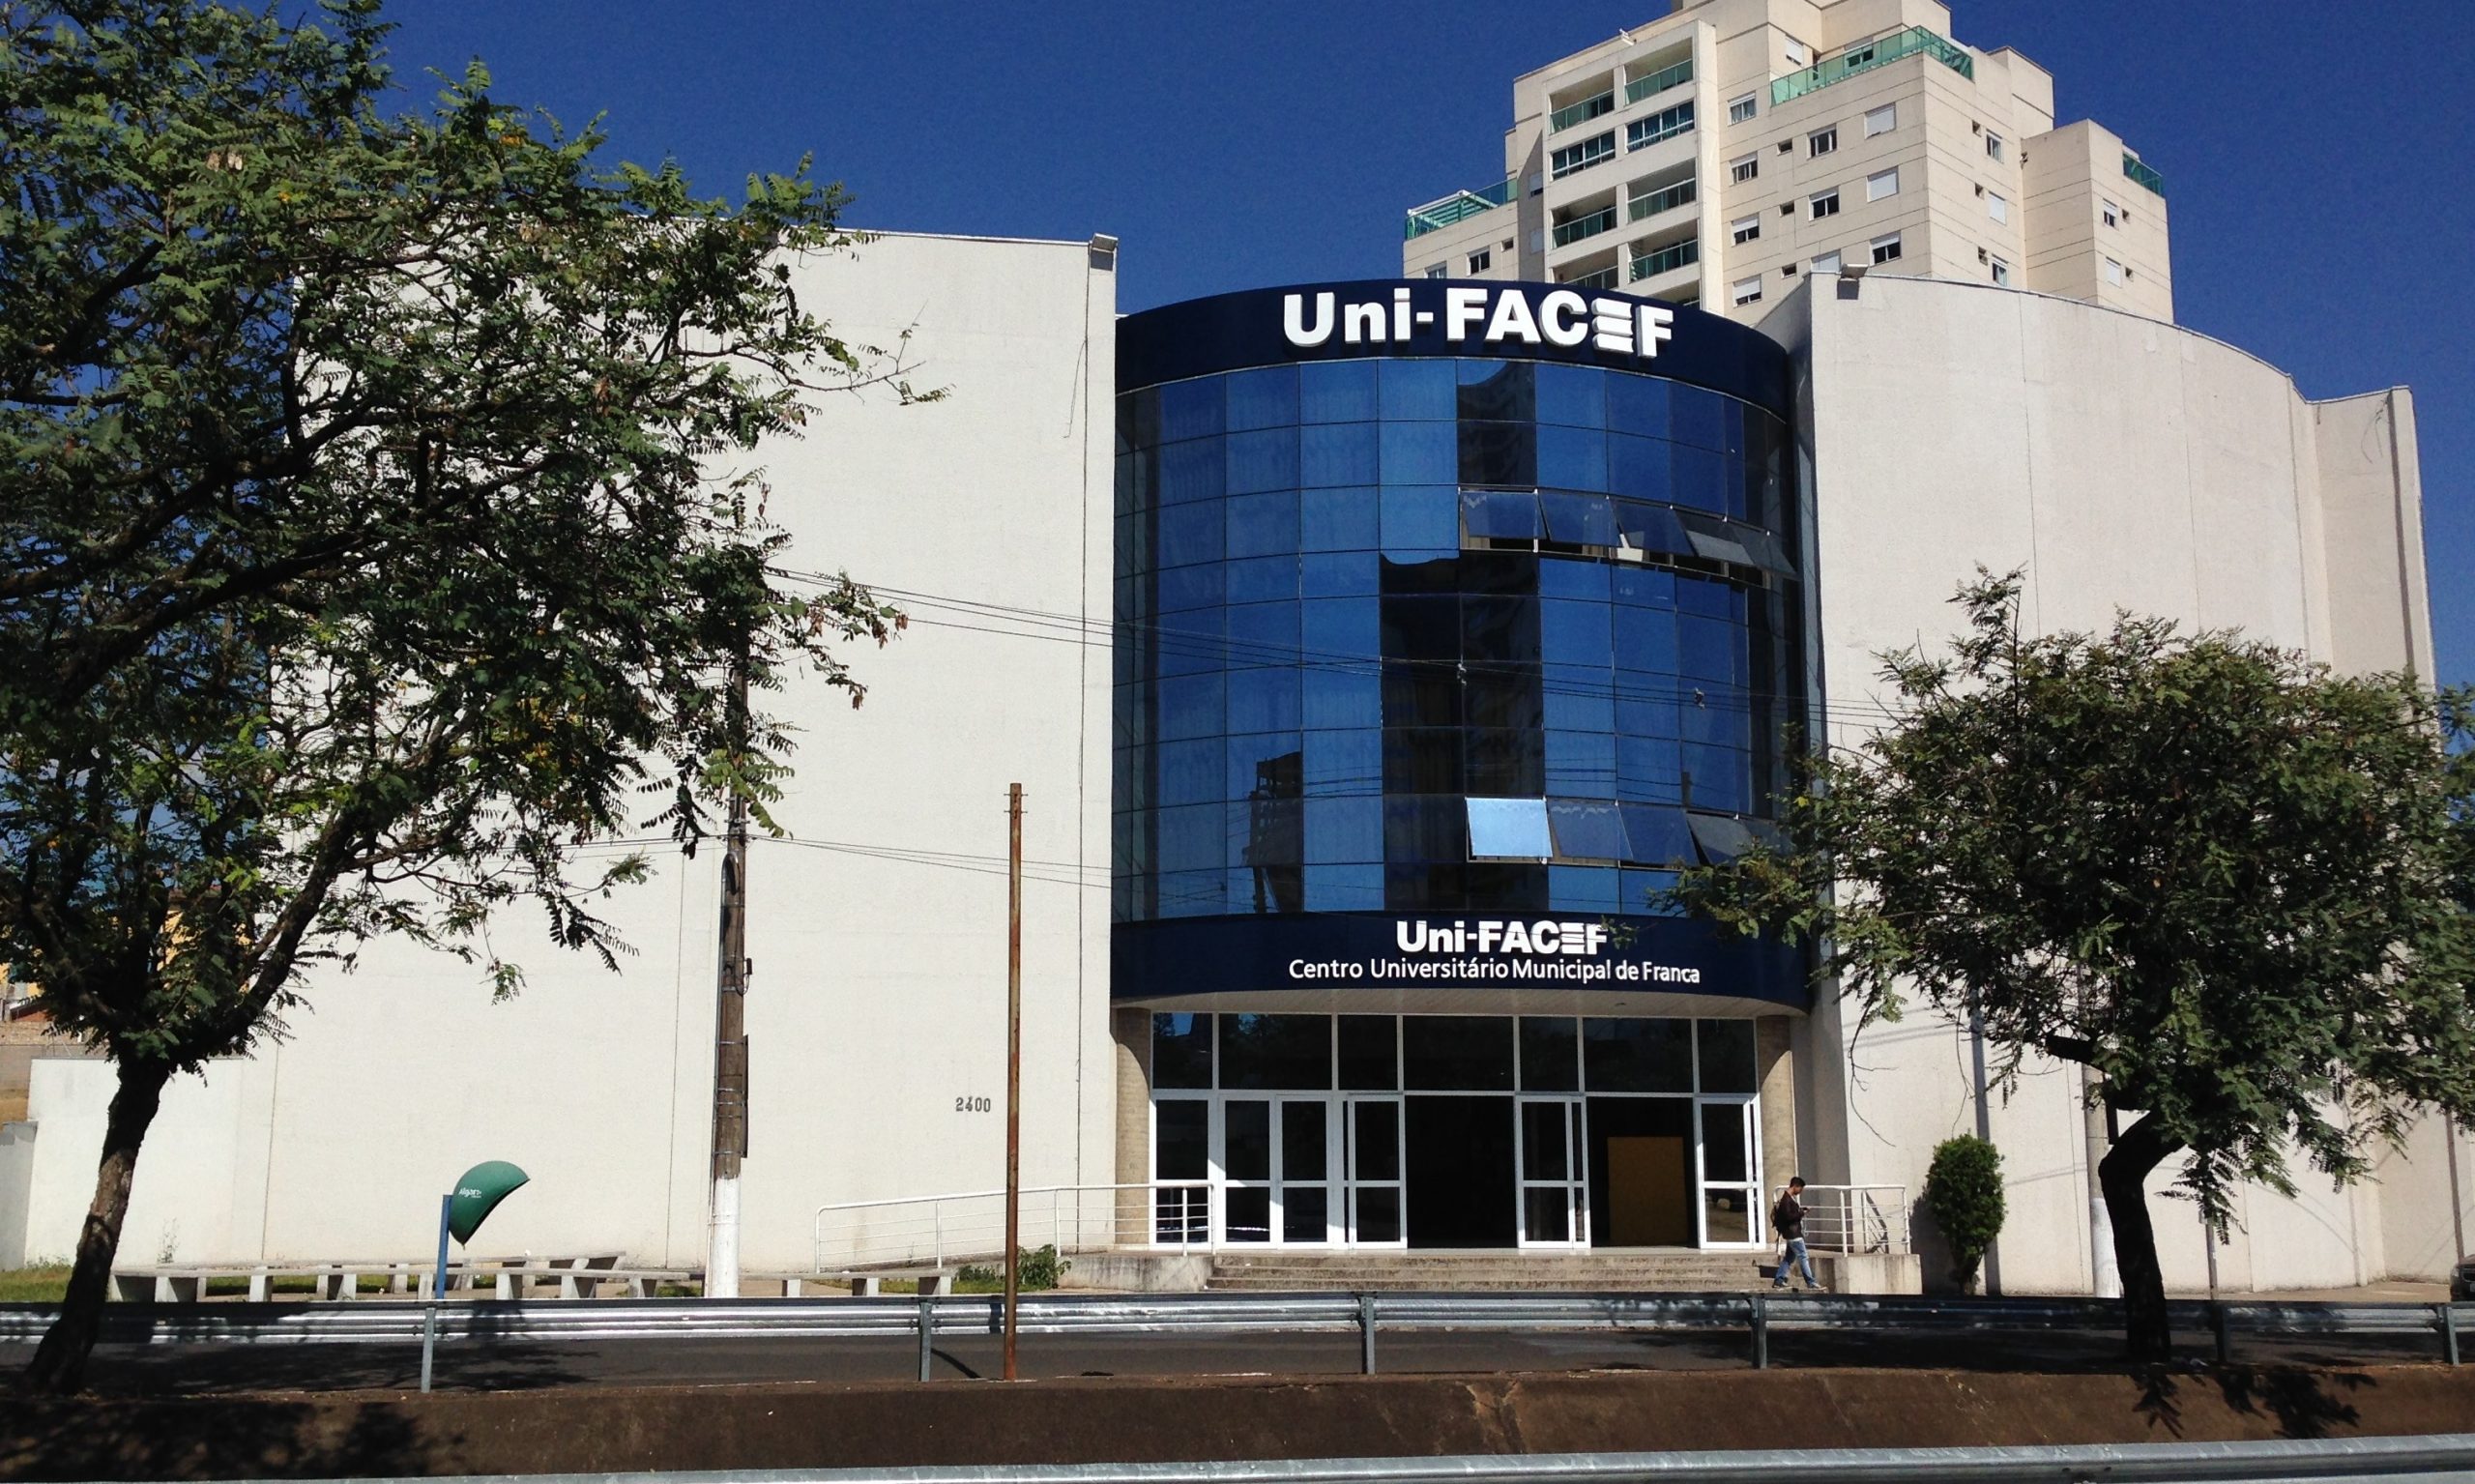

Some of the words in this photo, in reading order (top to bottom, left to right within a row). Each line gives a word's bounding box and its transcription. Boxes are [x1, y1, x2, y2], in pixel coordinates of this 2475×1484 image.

[1283, 287, 1674, 359] Uni-FACEF
[1396, 919, 1609, 955] Uni-FACEF
[1289, 959, 1363, 978] Centro
[1371, 957, 1509, 978] Universitário
[1512, 959, 1611, 984] Municipal
[1615, 959, 1639, 980] de
[1642, 961, 1701, 983] Franca
[955, 1095, 991, 1113] 2400
